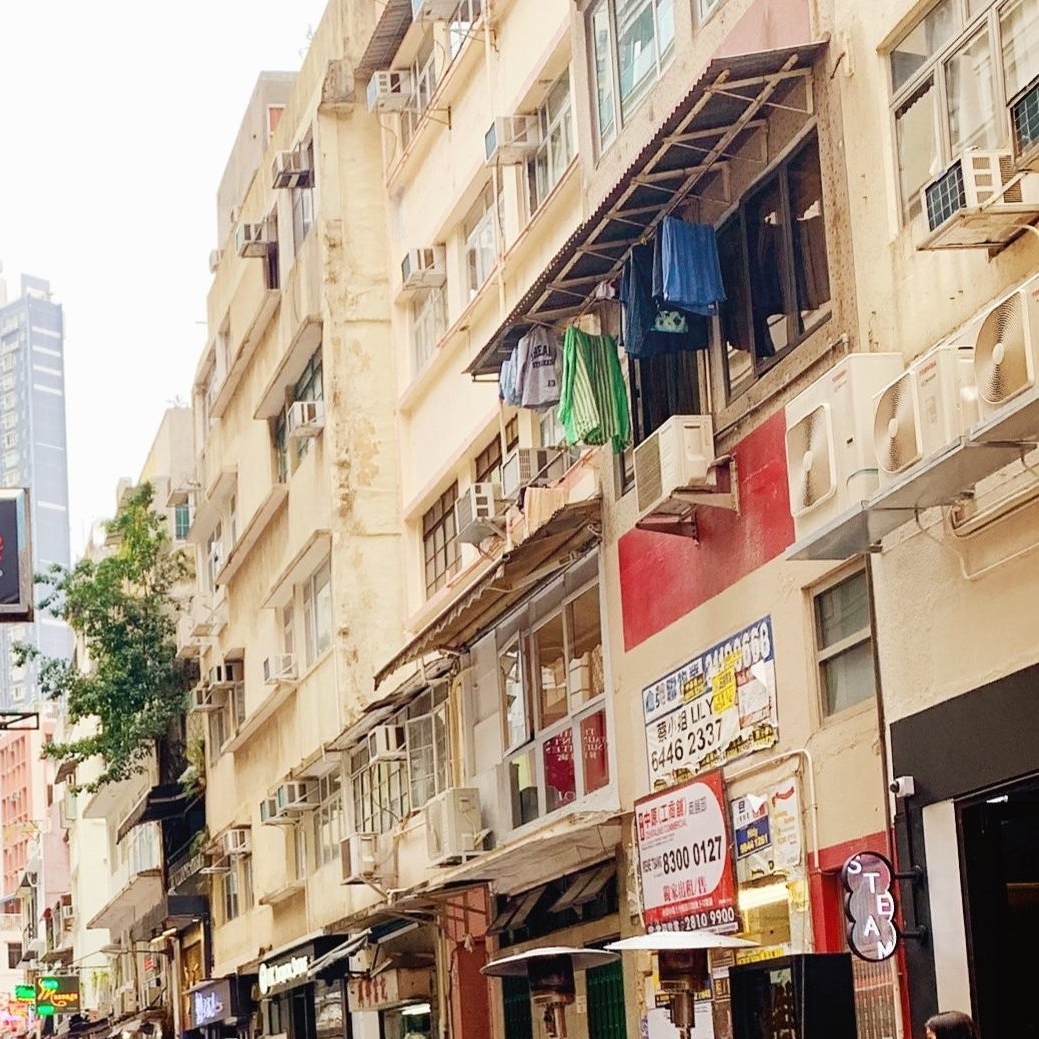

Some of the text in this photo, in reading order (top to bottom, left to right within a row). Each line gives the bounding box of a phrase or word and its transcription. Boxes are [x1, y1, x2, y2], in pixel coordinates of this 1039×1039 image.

[690, 695, 714, 724] LILY
[651, 718, 722, 773] 6446 2337
[663, 845, 690, 875] 8300
[693, 835, 722, 866] 0127
[684, 911, 708, 931] 2810
[710, 906, 735, 925] 9900
